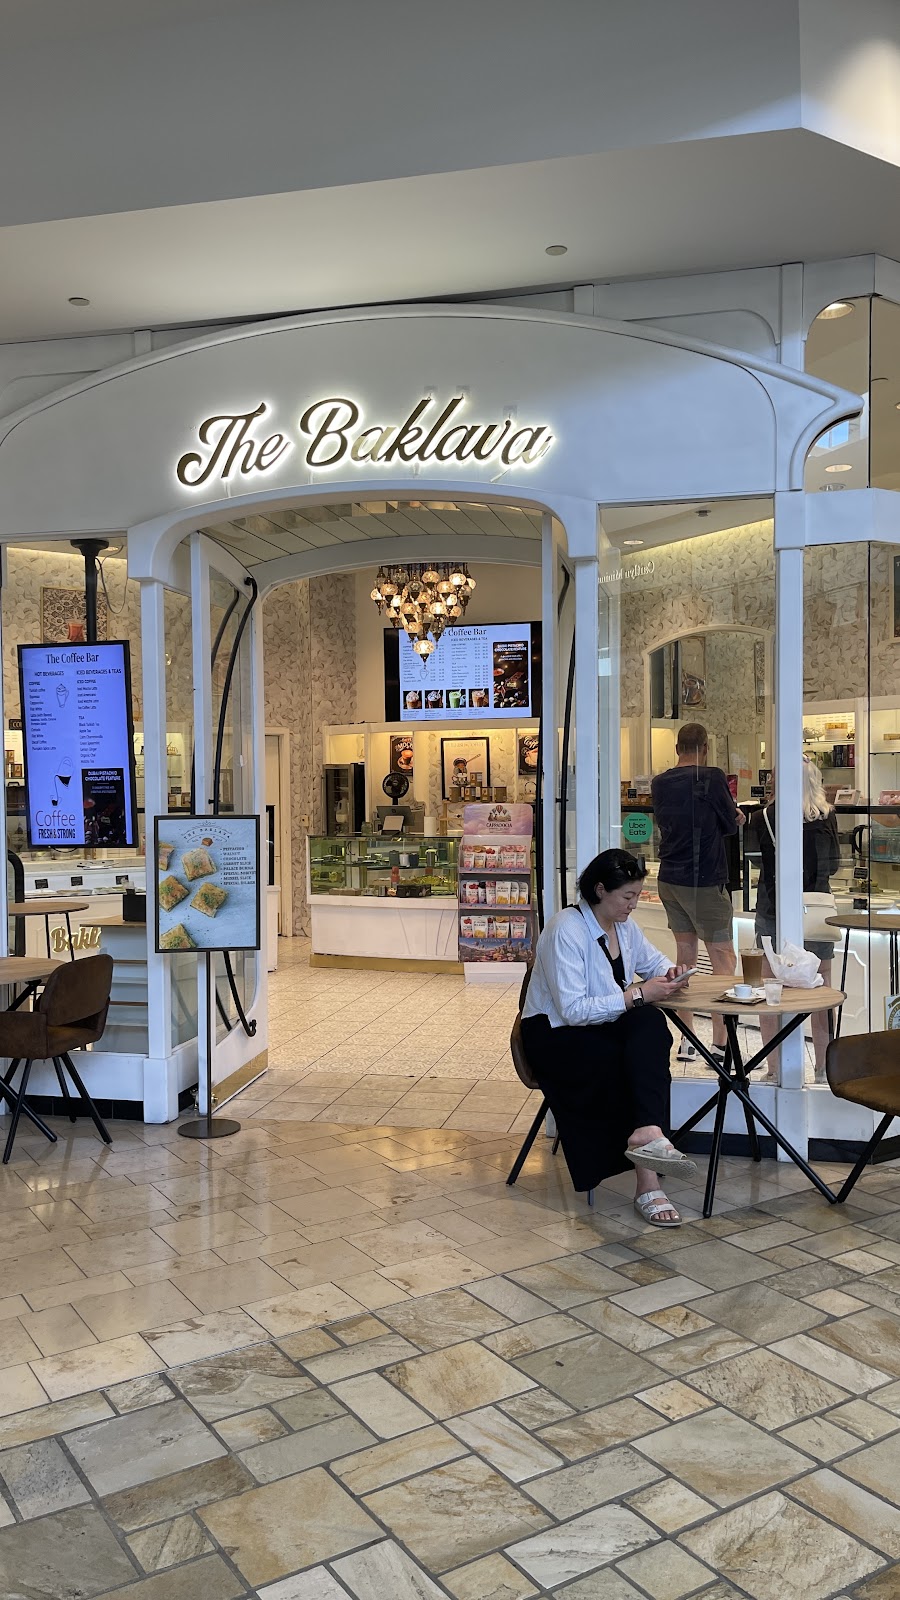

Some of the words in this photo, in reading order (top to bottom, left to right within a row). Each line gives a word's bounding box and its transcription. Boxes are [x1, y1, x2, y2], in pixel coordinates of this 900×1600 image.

[176, 402, 292, 487] The
[300, 397, 554, 468] Baklava
[46, 653, 60, 664] The
[61, 652, 85, 664] Coffee
[86, 653, 99, 663] Bar
[35, 810, 76, 827] Coffee
[628, 821, 647, 829] Uber
[38, 828, 53, 839] FRESH
[53, 829, 57, 839] &
[57, 828, 76, 839] STRONG
